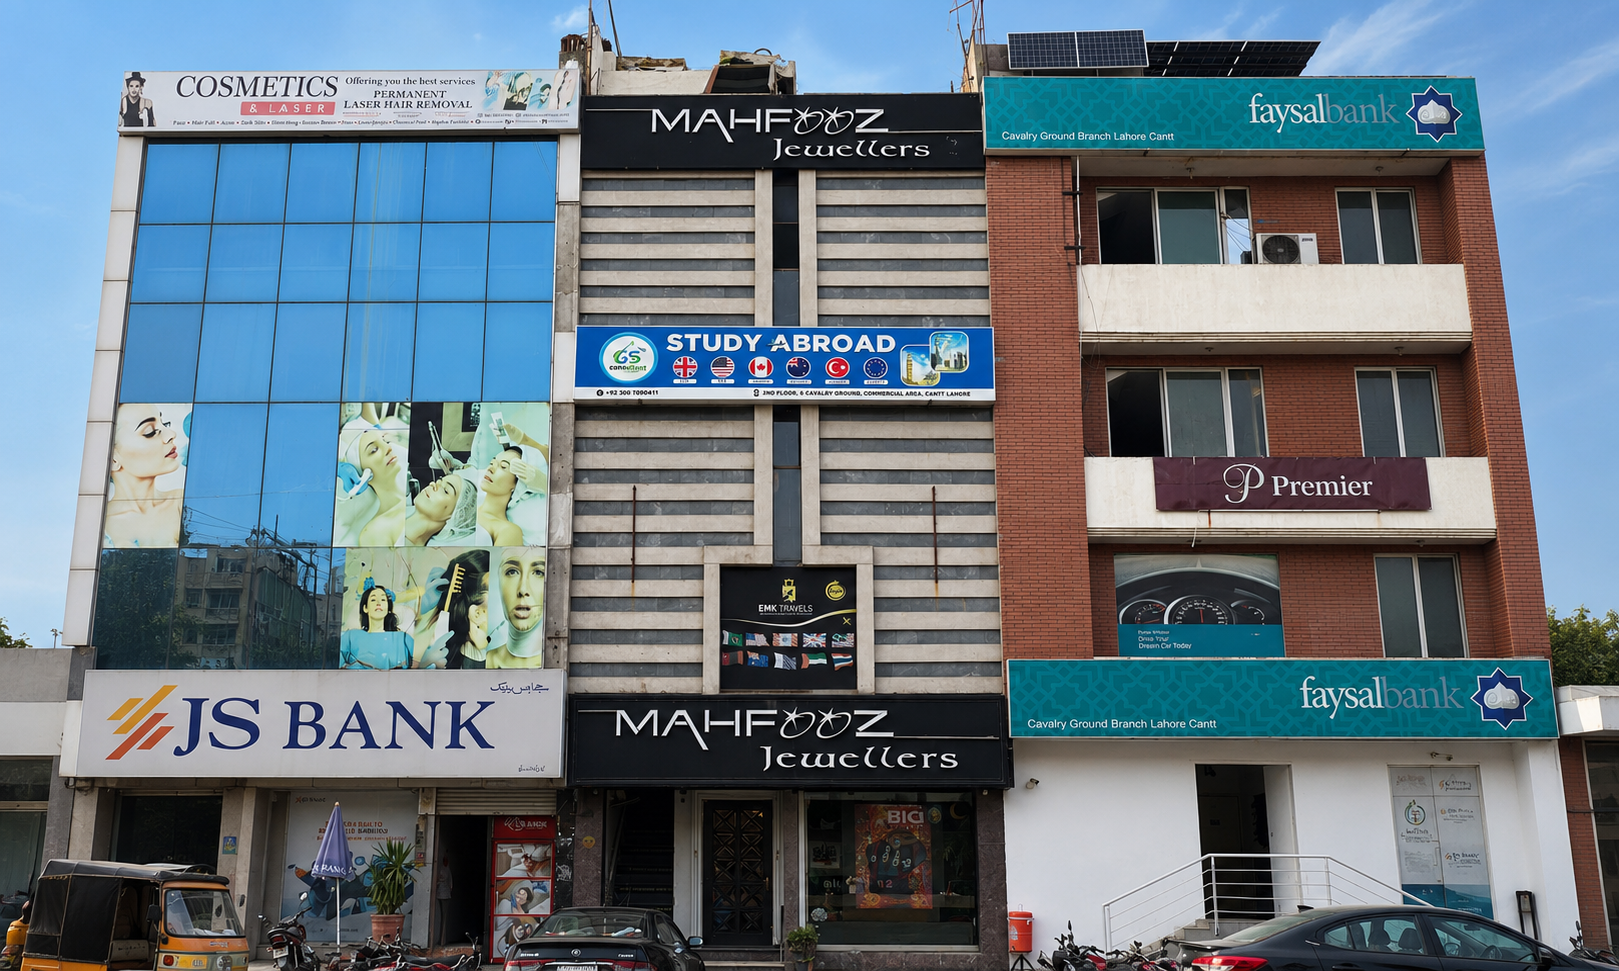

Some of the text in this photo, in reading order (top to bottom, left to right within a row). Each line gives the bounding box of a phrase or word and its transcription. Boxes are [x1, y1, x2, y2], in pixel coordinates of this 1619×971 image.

[176, 75, 339, 98] COSMETICS
[345, 77, 383, 87] Offering
[385, 79, 400, 87] you
[402, 77, 418, 86] the
[439, 77, 476, 86] services
[343, 100, 473, 109] LASER HAIR REMOVAL
[373, 90, 447, 99] PERMANENT
[249, 103, 325, 113] & LASER
[1248, 92, 1400, 134] faysalbank
[651, 106, 889, 143] MAHFOOZ
[1002, 131, 1175, 143] Cavalry Ground Branch Lahore Cantt
[772, 138, 931, 161] Jewellers
[666, 333, 897, 354] STUDY ABROAD
[1271, 474, 1373, 497] Premier
[758, 604, 777, 613] EMK
[1173, 642, 1192, 650] Today
[1299, 675, 1464, 719] faysalbank
[173, 696, 496, 757] JS BANK
[615, 706, 895, 751] MAHFOOZ
[1028, 719, 1217, 731] Cavalry Ground Branch Lahore Cantt
[760, 746, 960, 771] Jewellers
